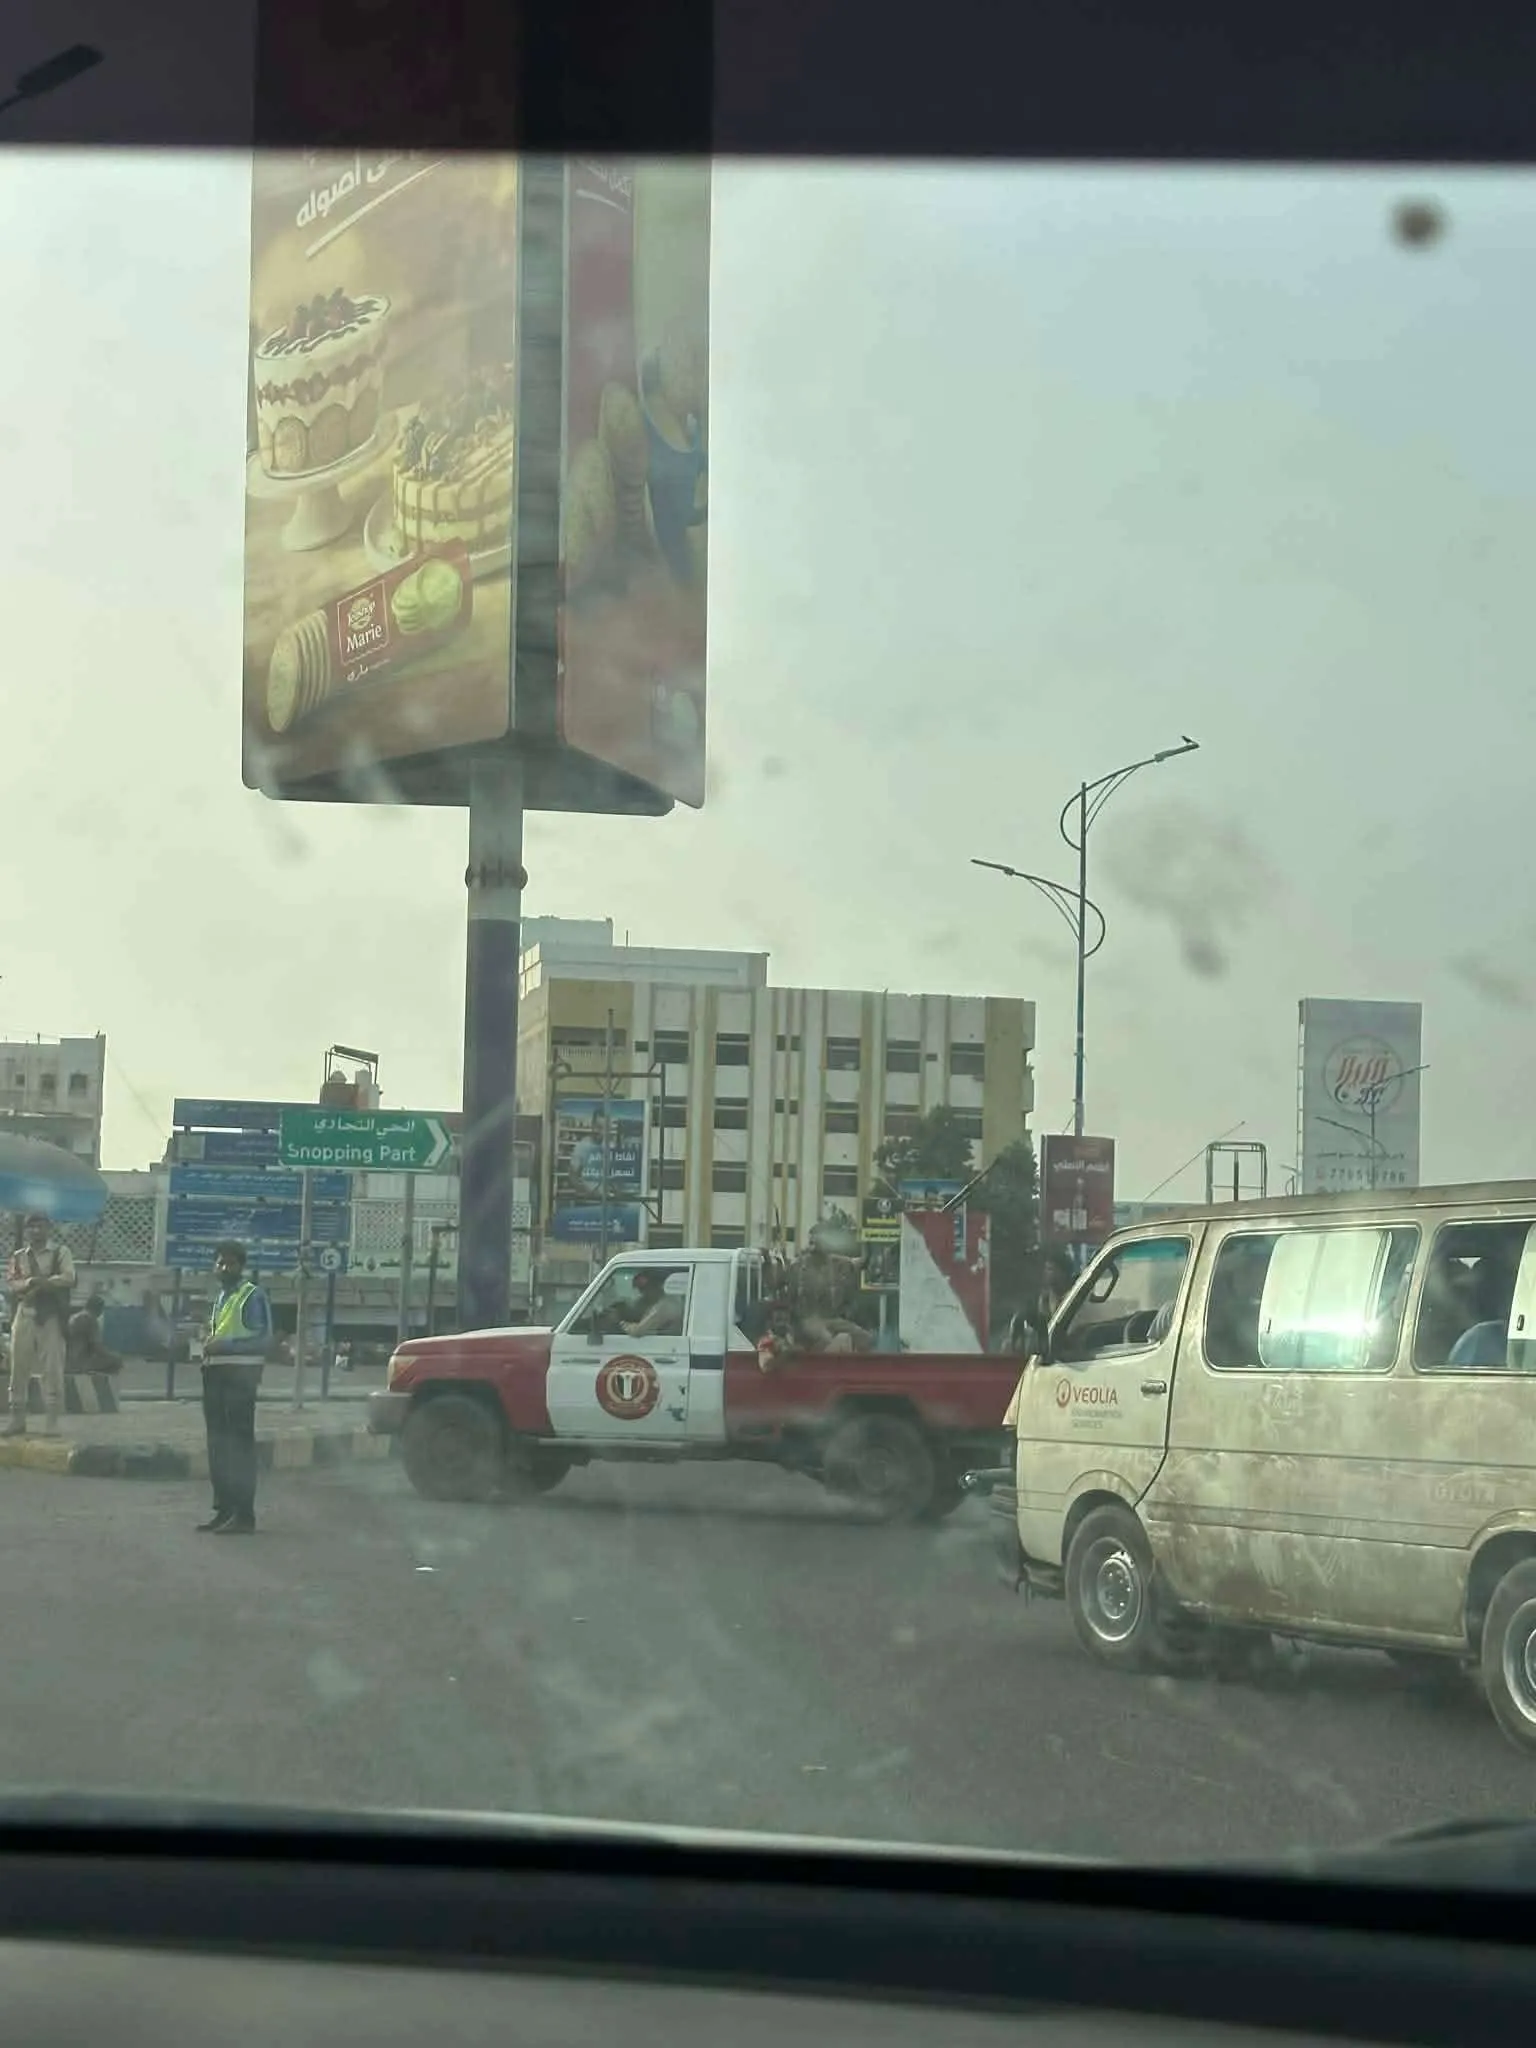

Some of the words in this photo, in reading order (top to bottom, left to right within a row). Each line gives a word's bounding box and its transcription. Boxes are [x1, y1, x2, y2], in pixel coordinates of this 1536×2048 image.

[346, 623, 383, 653] Marie
[379, 1145, 417, 1162] Part
[1072, 1387, 1119, 1405] VEOLIA
